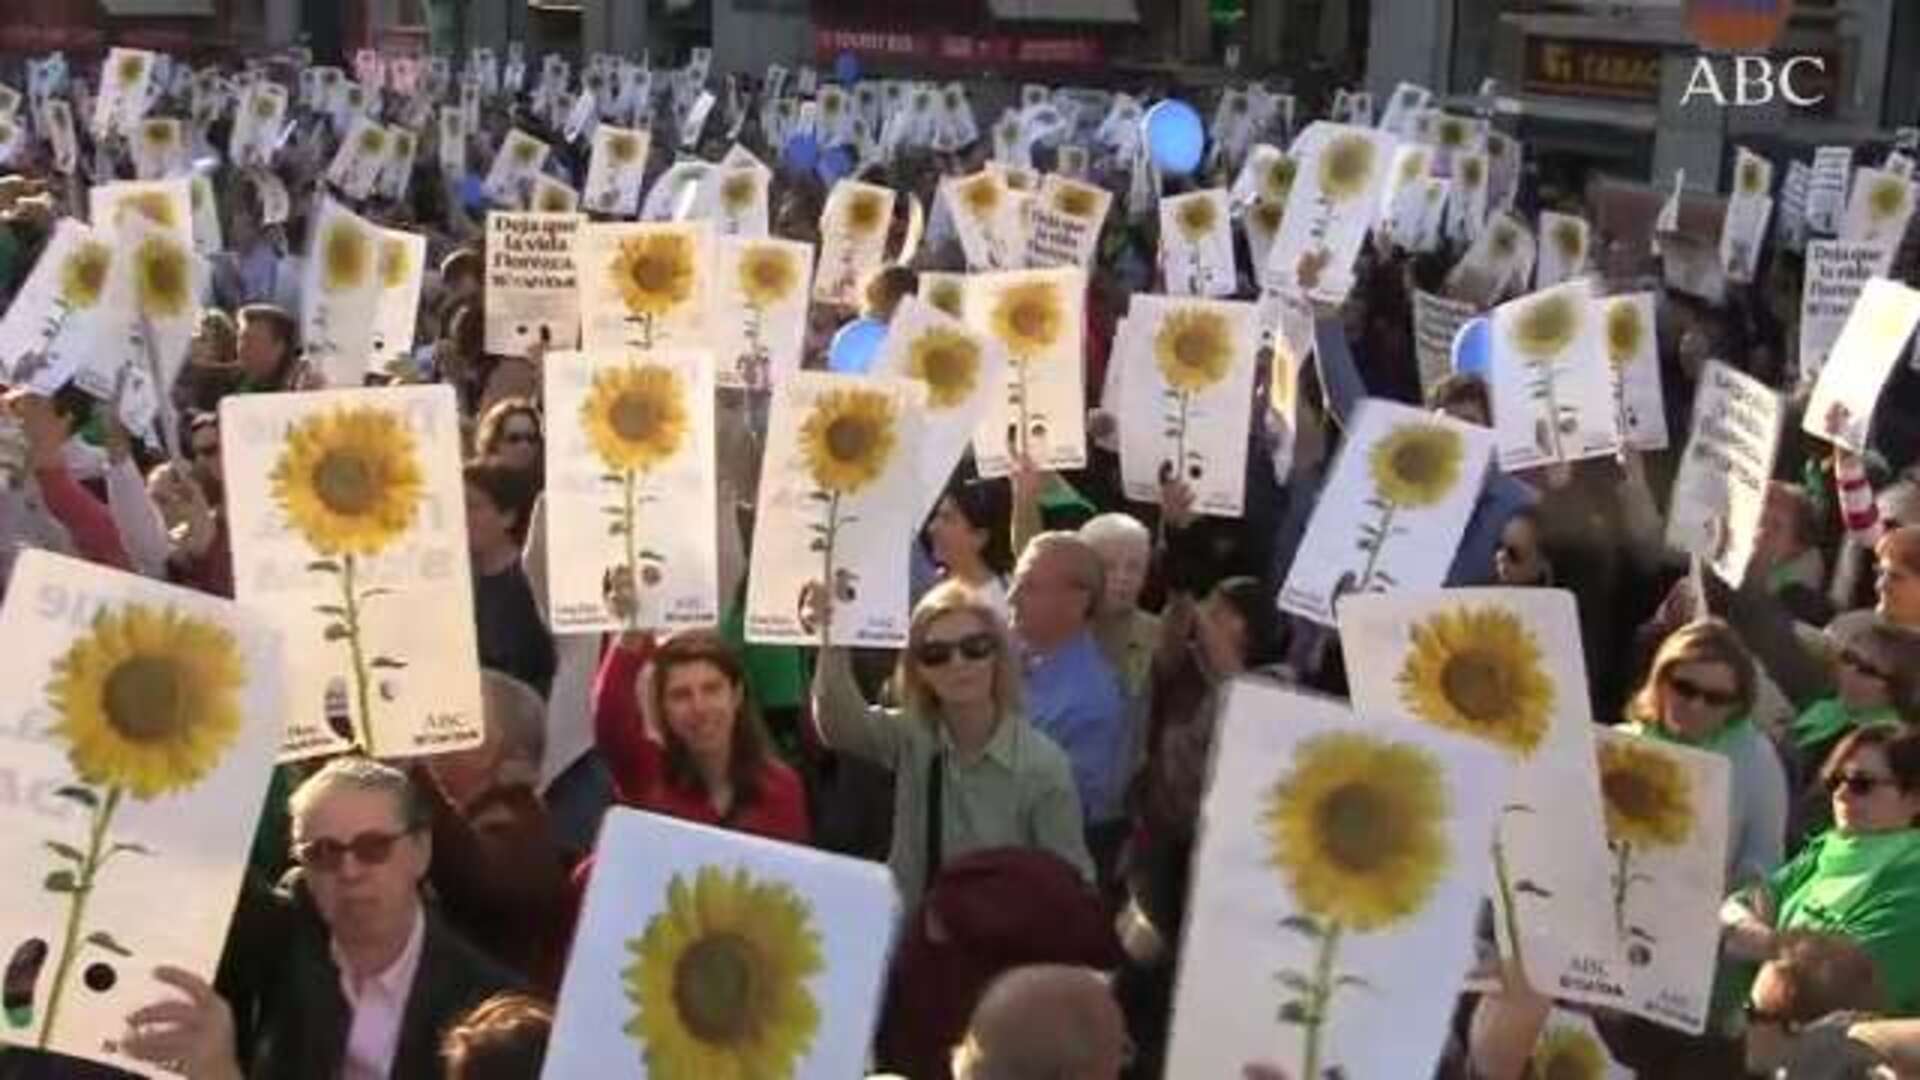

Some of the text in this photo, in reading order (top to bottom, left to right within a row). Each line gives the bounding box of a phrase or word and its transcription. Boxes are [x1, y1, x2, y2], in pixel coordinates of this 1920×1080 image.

[495, 216, 577, 241] Deja que
[505, 234, 568, 252] la vida
